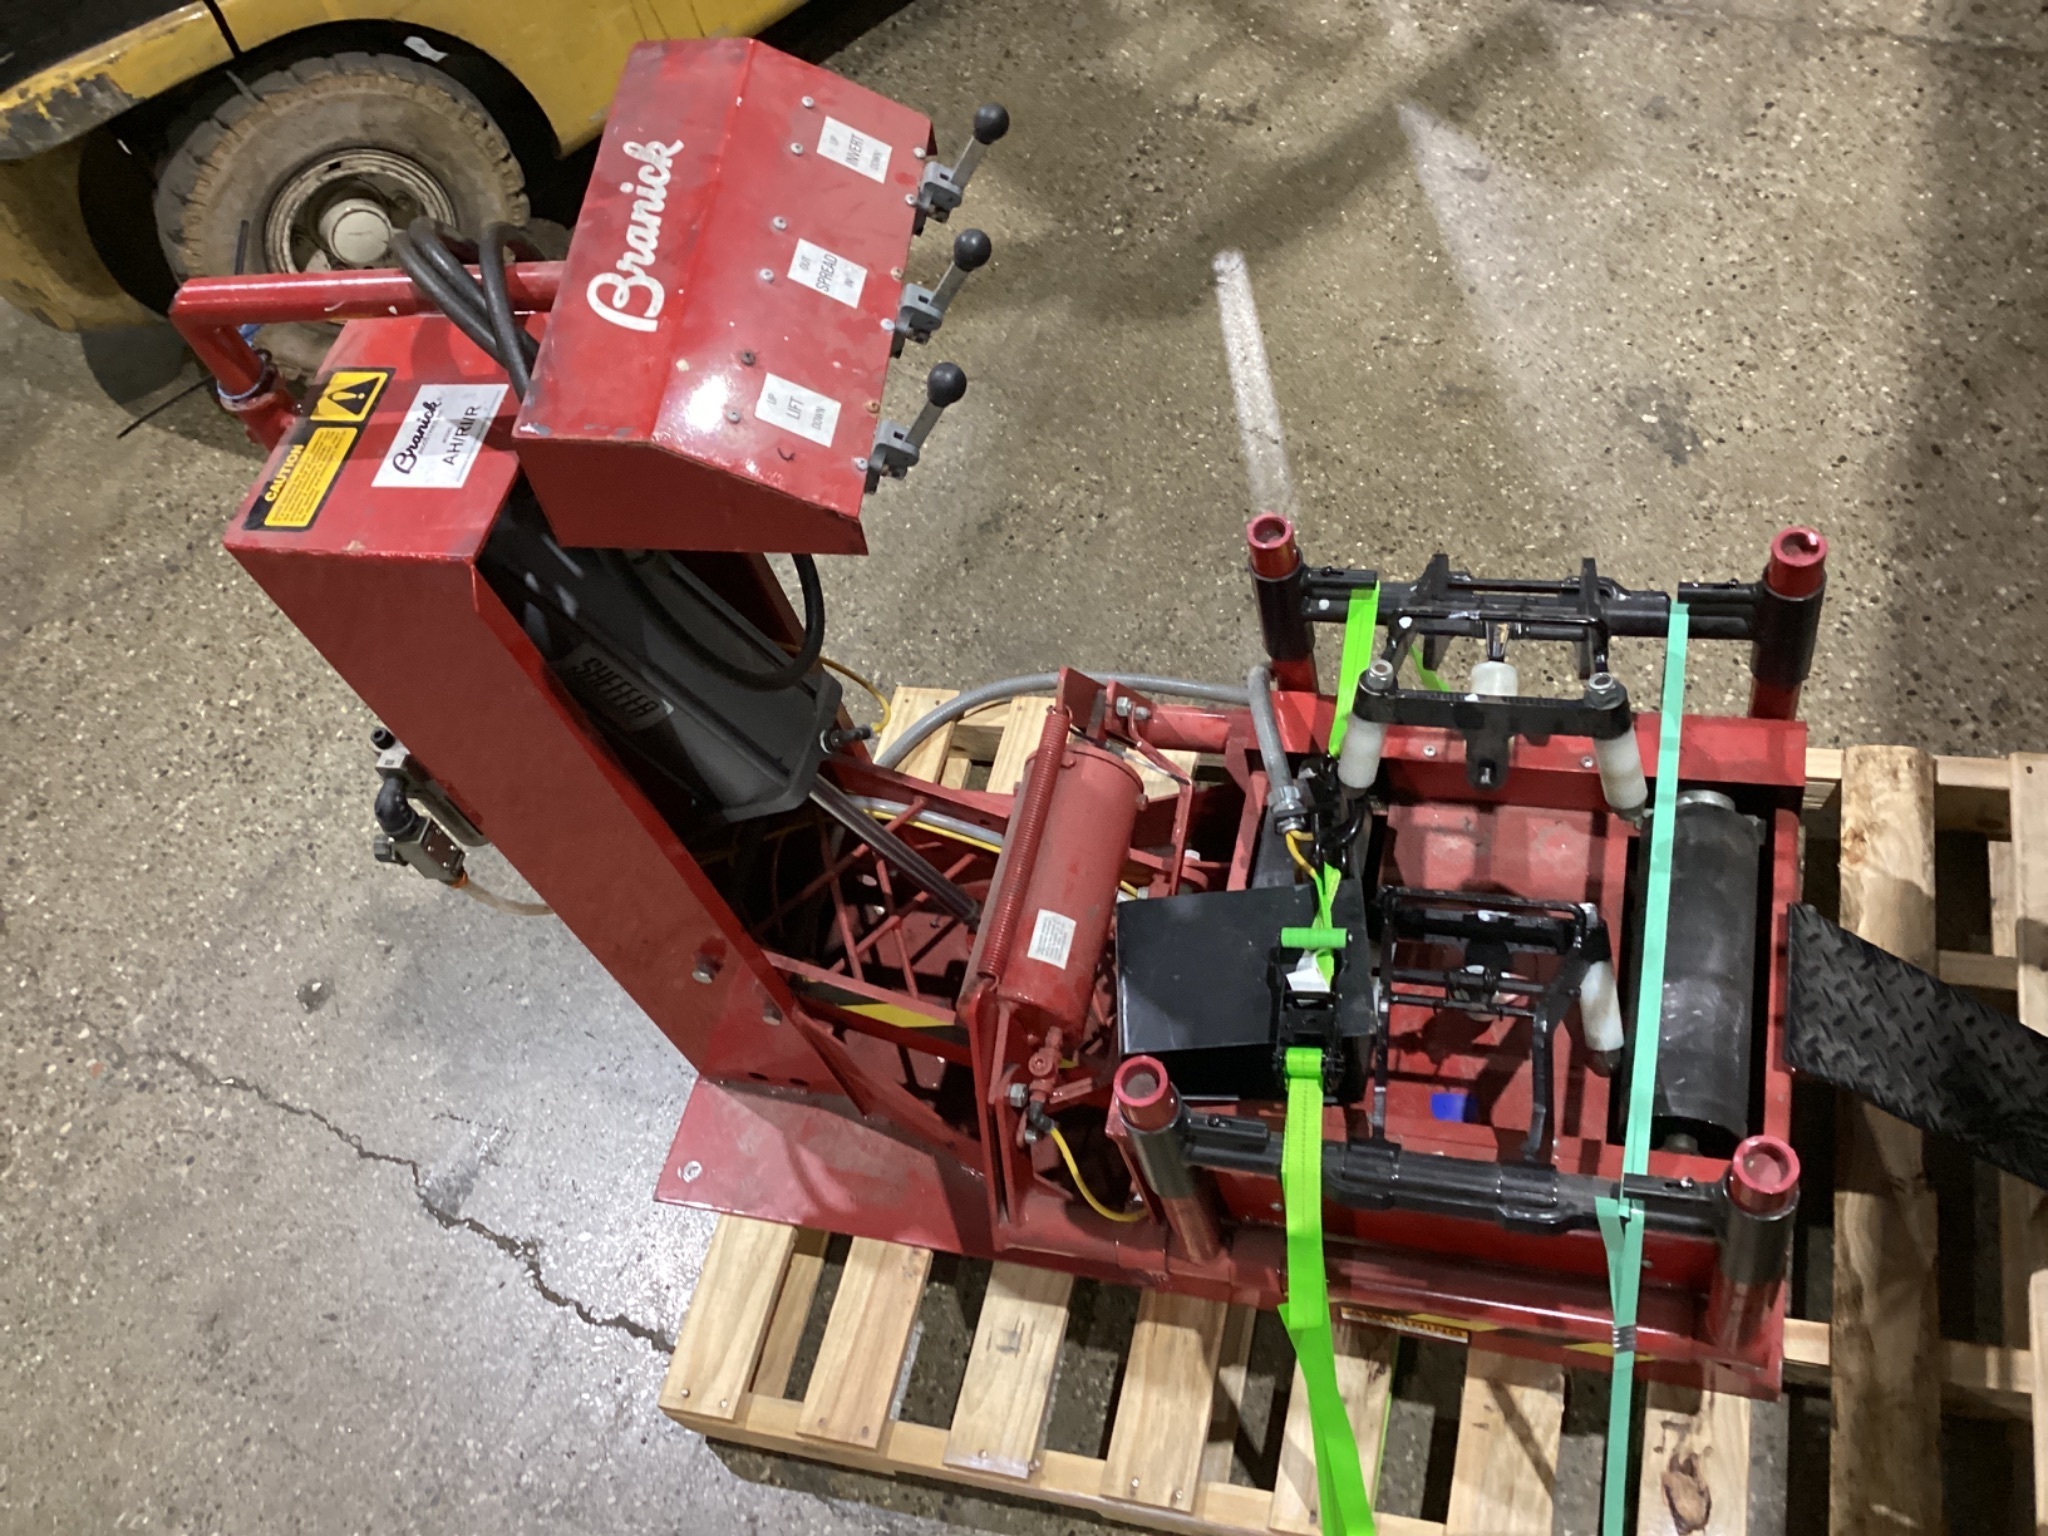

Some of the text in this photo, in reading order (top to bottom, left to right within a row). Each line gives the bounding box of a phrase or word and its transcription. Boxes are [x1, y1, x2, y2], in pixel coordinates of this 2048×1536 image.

[845, 133, 864, 167] INVERT
[586, 139, 684, 332] Branick
[799, 254, 811, 271] OUT
[815, 253, 838, 292] SPREAD
[766, 392, 777, 405] UP
[786, 396, 804, 420] LIFT
[811, 406, 826, 431] DOWN
[392, 400, 442, 474] Branick
[264, 444, 304, 502] CAUTION
[573, 658, 659, 718] SHEFFER
